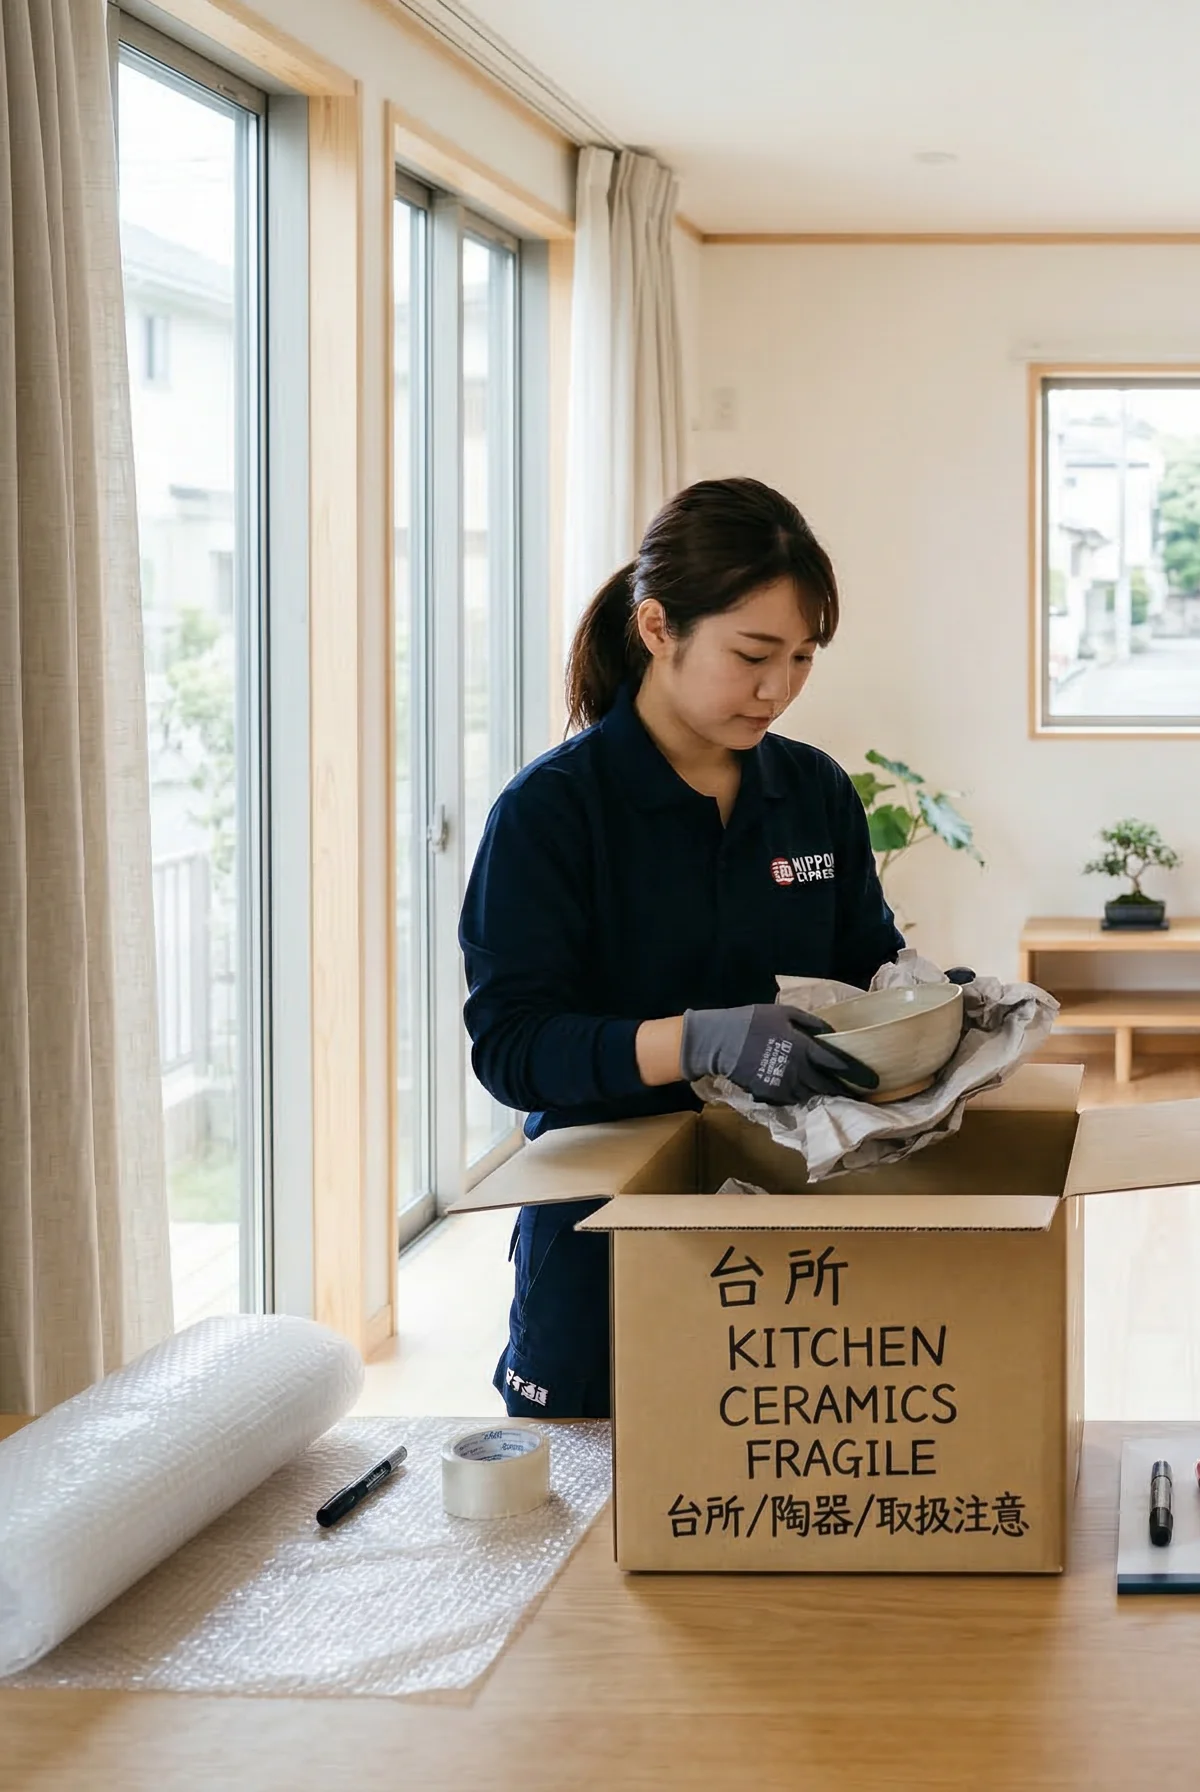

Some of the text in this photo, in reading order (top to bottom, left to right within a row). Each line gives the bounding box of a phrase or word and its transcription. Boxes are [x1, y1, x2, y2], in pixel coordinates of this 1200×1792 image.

[710, 1245, 849, 1307] 台所
[728, 1324, 947, 1370] KITCHEN
[719, 1383, 958, 1427] CERAMICS
[746, 1438, 937, 1479] FRAGILE
[667, 1491, 1030, 1538] 台所/陶器/取扱注意
